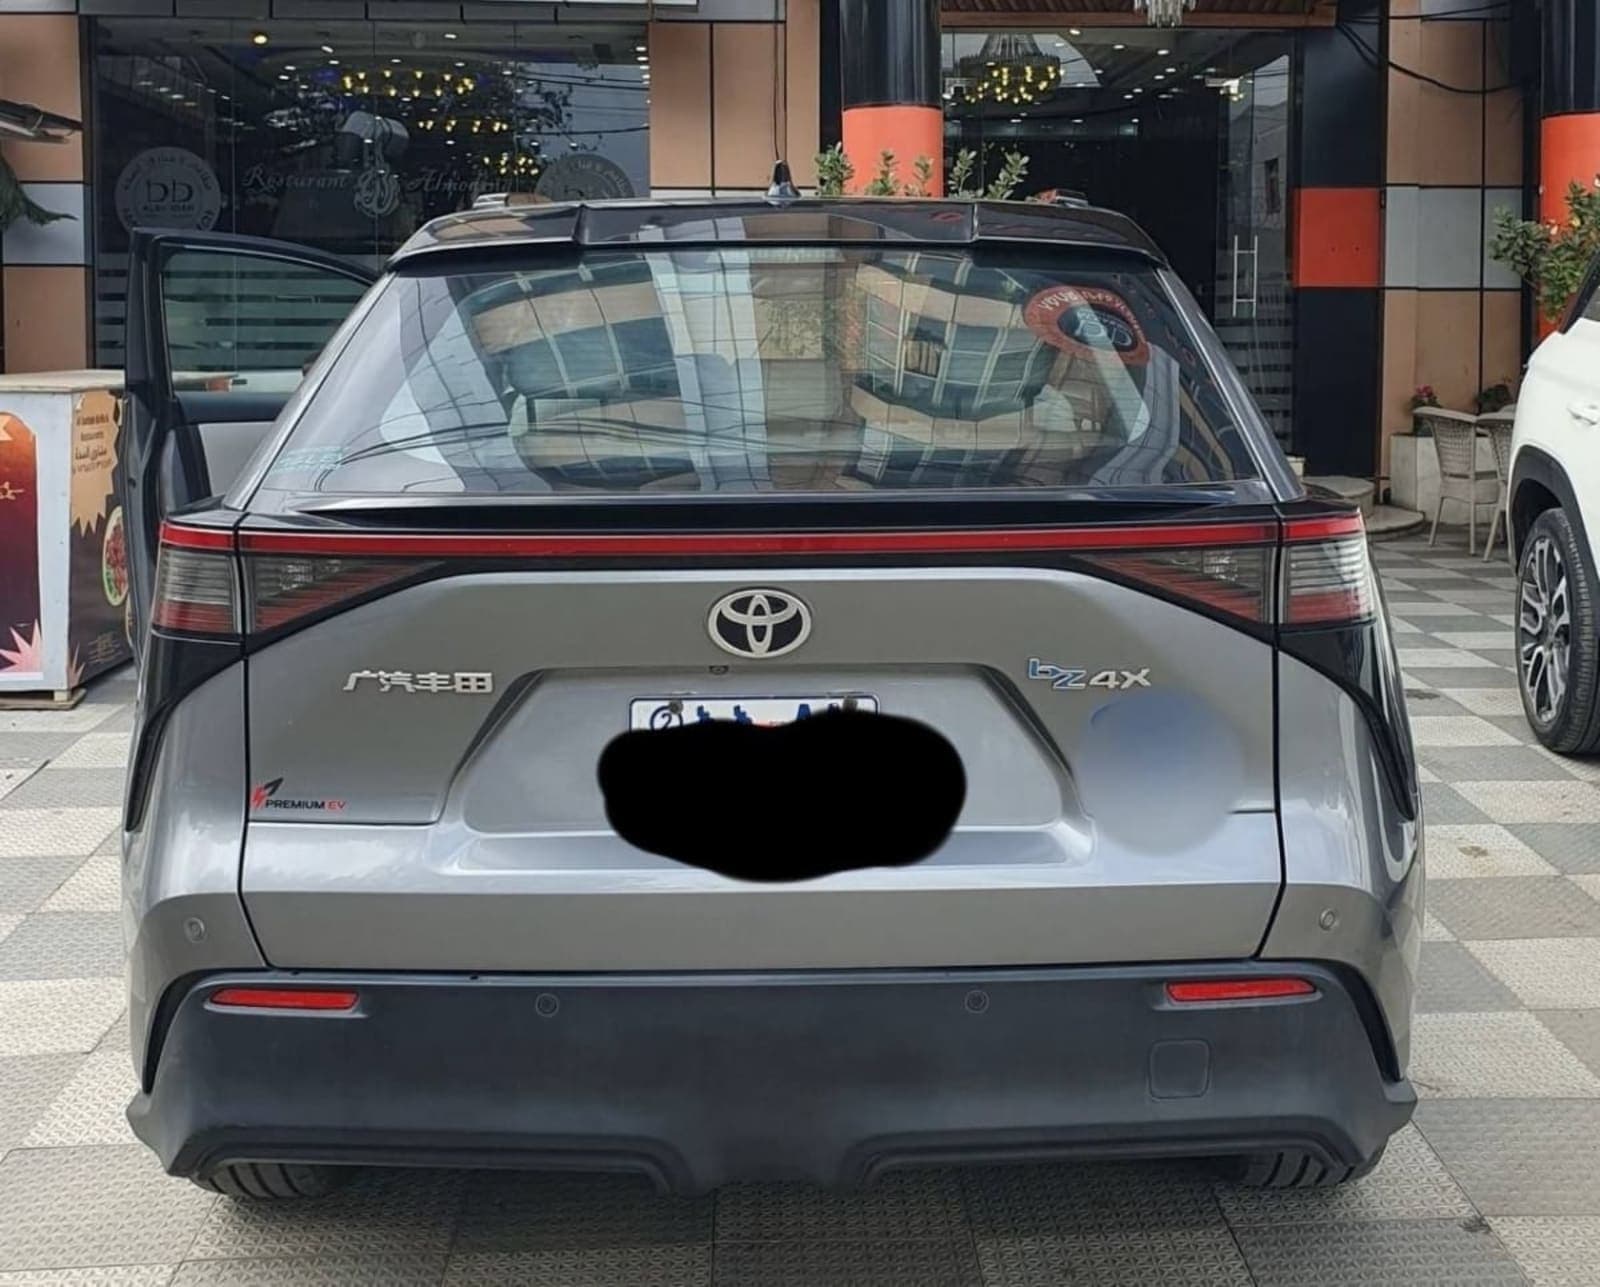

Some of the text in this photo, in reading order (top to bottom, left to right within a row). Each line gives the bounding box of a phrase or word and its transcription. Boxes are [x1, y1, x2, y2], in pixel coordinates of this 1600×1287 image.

[343, 670, 493, 693] 广汽丰田
[265, 799, 346, 809] PREMIUM EV
